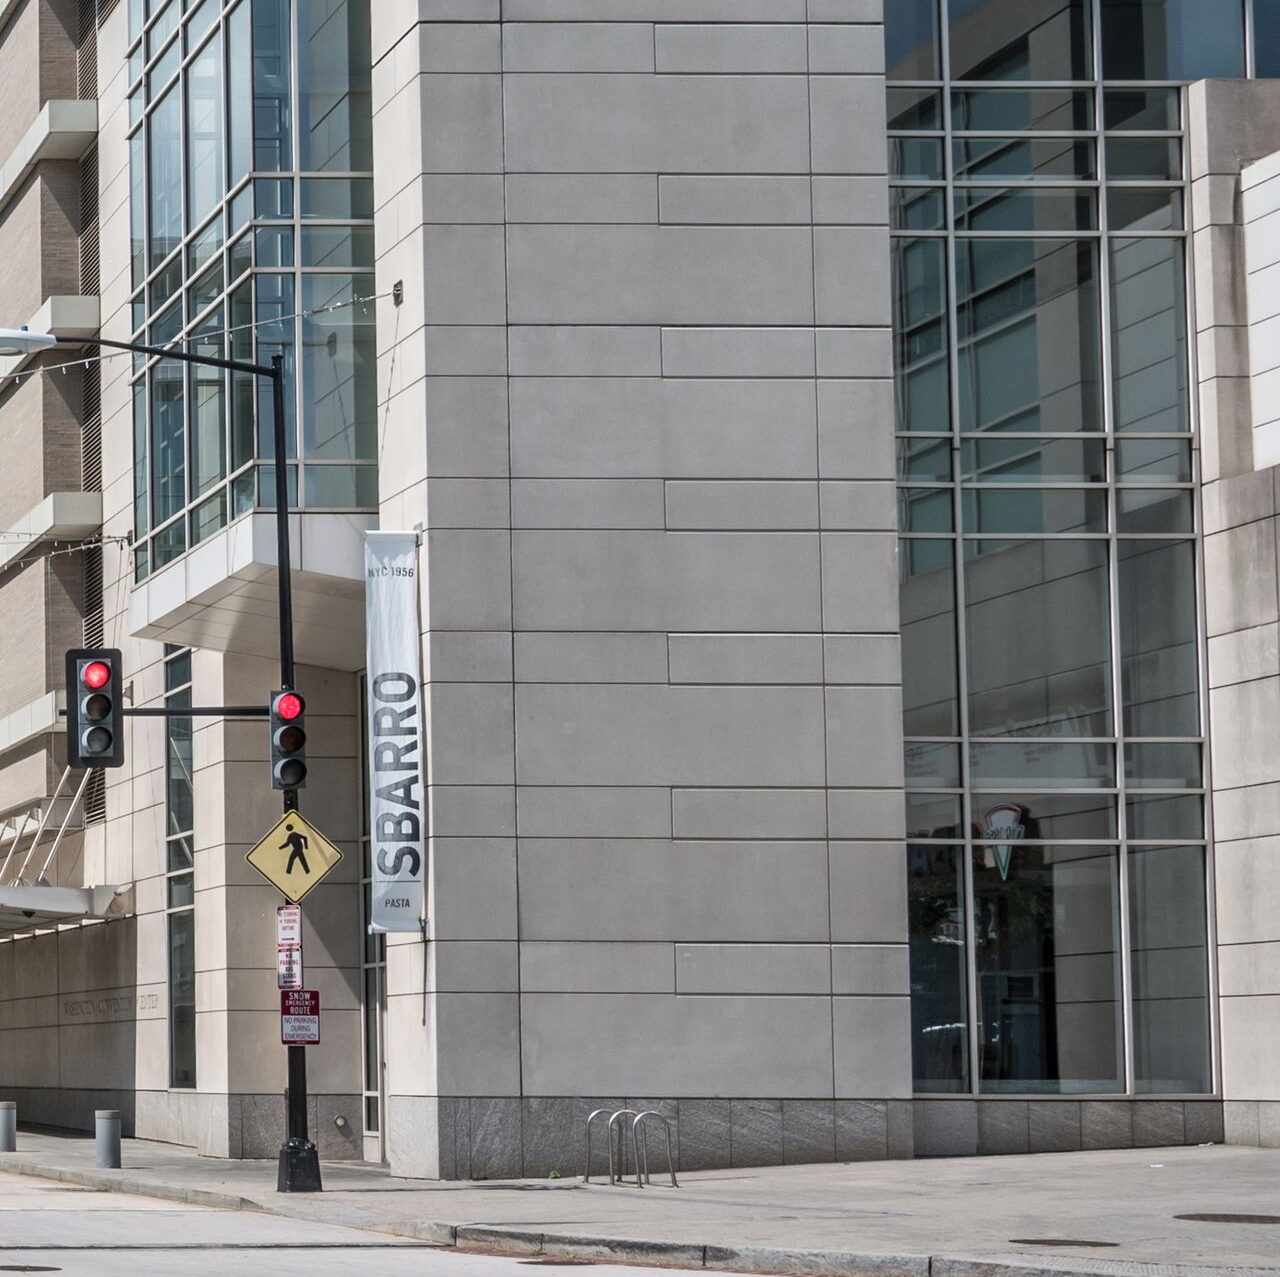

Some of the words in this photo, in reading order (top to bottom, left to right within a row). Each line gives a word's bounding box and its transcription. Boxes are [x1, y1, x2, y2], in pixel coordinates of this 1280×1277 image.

[368, 566, 388, 578] NYC
[391, 566, 415, 578] 1956
[372, 672, 421, 877] SBARRO
[385, 898, 410, 908] PASTA
[288, 992, 311, 1000] SNOW
[289, 1006, 311, 1014] ROUTE
